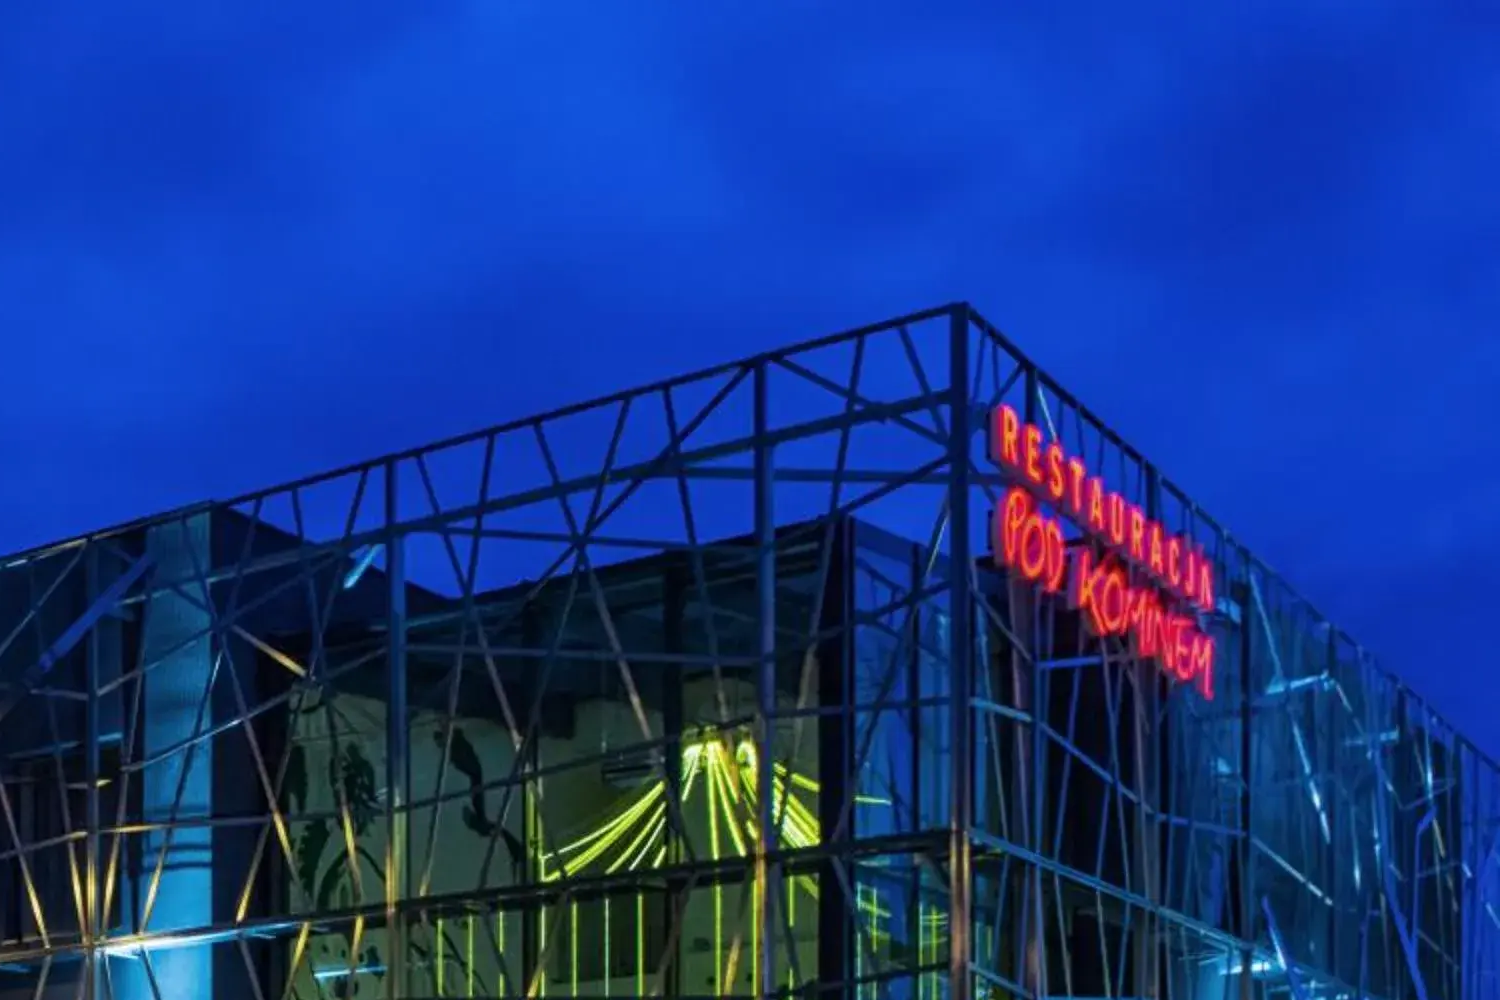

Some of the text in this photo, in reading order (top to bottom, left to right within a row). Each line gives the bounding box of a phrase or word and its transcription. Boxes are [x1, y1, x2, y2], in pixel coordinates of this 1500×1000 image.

[996, 403, 1213, 611] RESTAURACJA
[1002, 487, 1214, 700] POD KOMINEM
